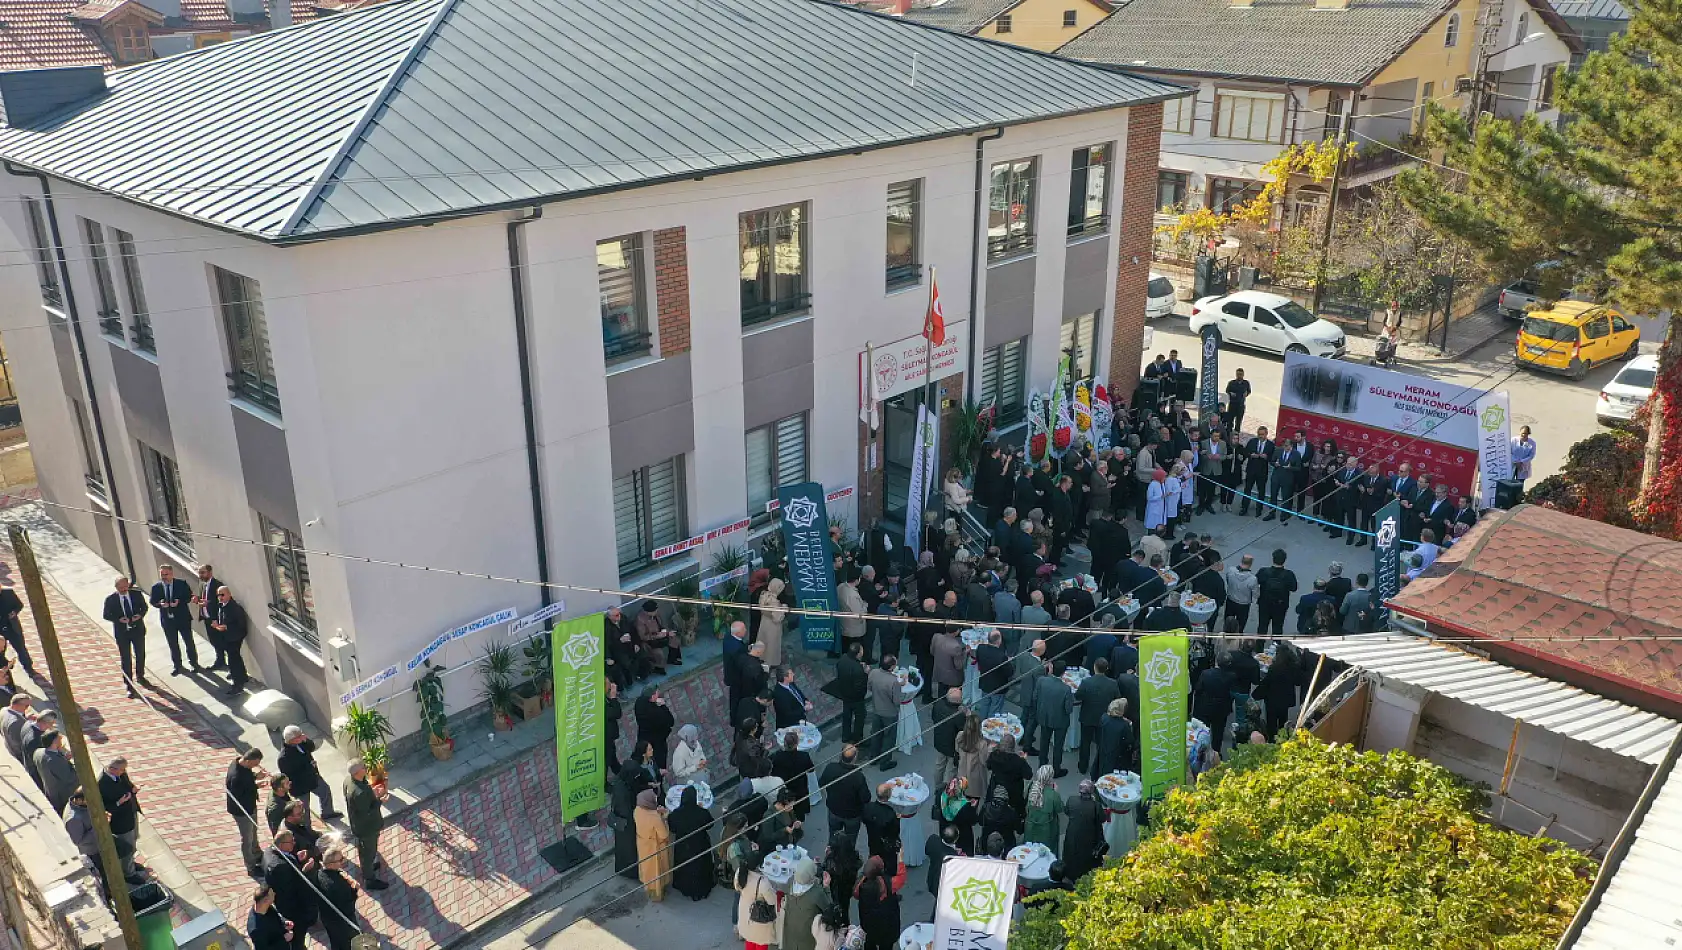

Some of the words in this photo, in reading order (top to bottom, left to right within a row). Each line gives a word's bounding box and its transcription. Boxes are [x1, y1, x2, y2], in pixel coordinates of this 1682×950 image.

[1369, 386, 1421, 405] SÜLEYMAN
[1404, 384, 1441, 399] MERAM
[578, 671, 597, 745] MERAM
